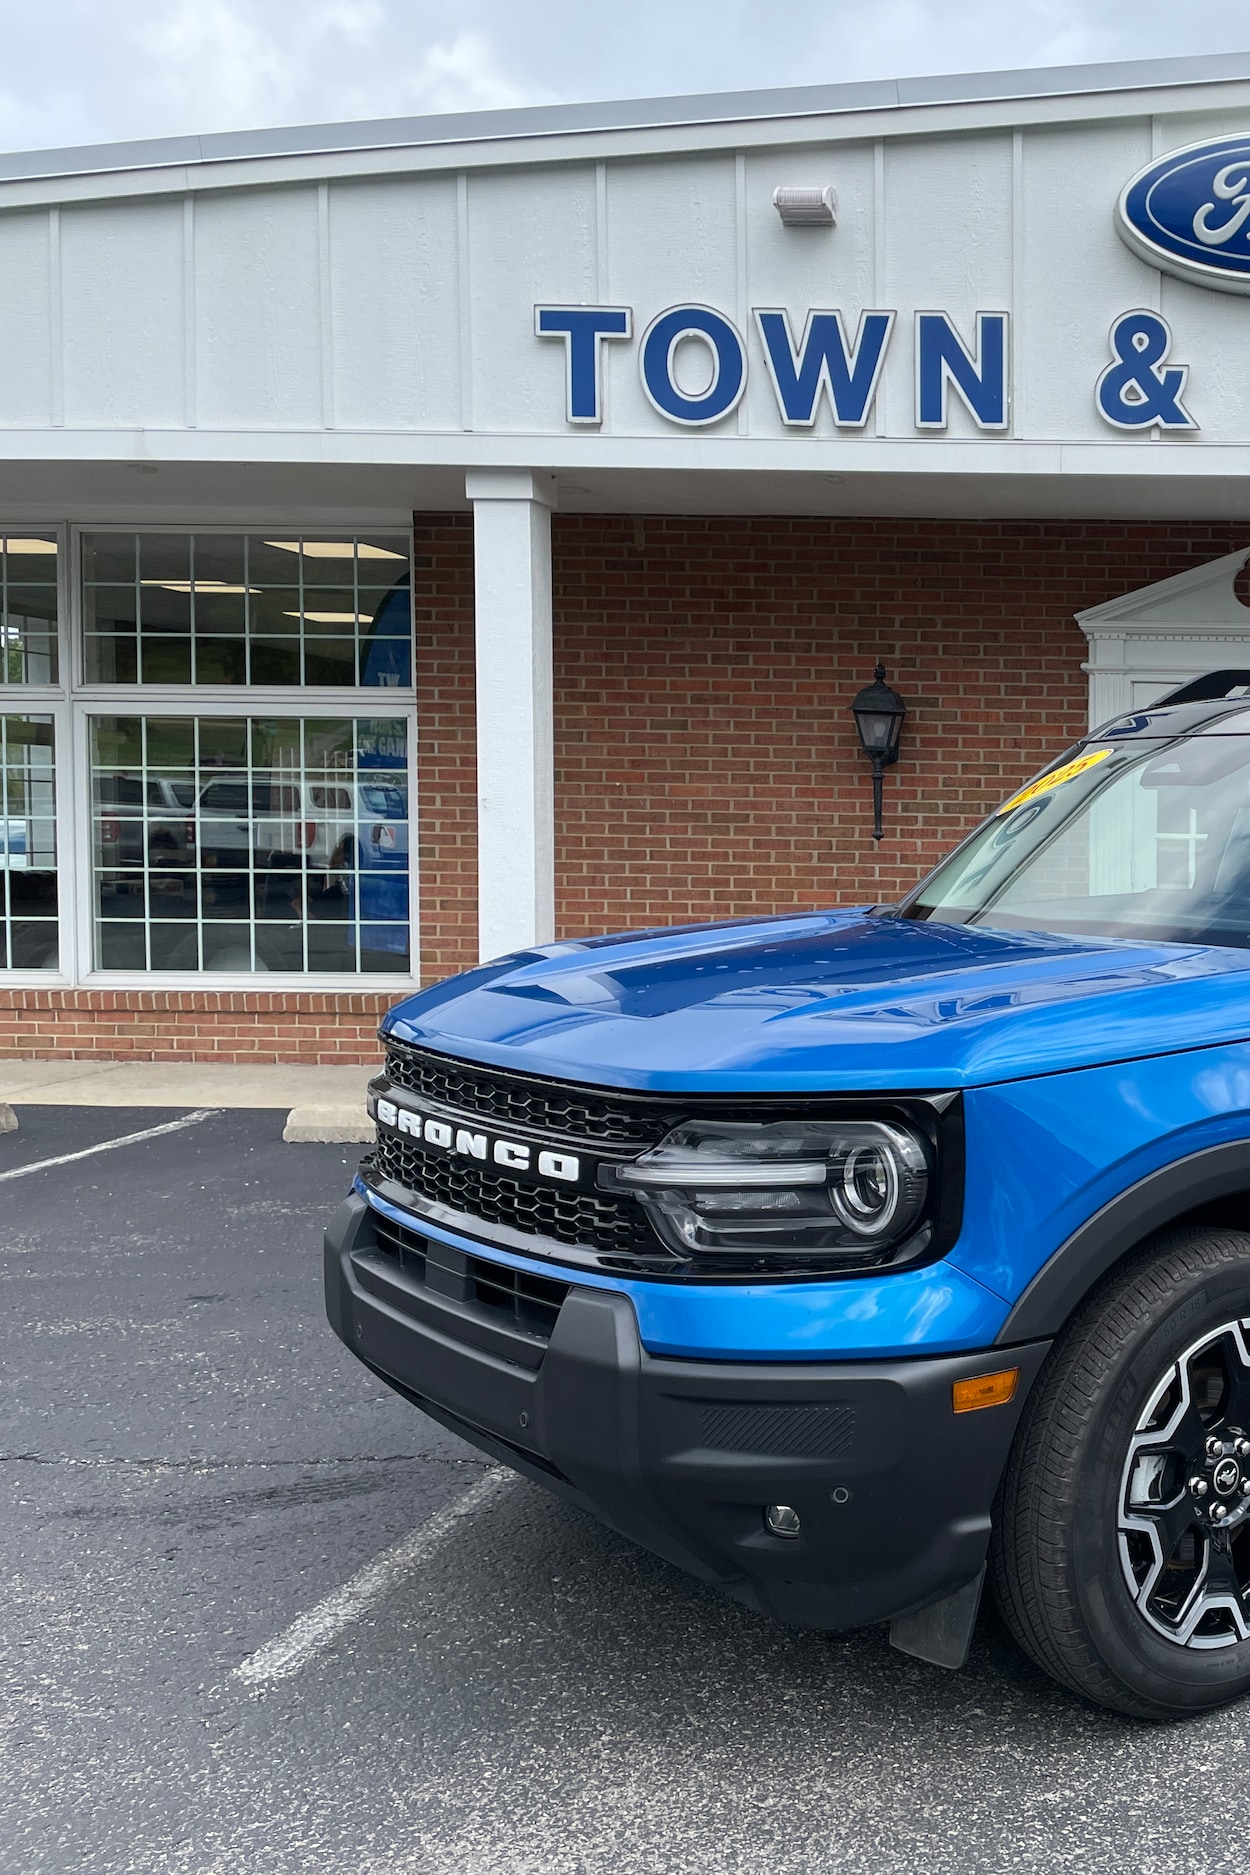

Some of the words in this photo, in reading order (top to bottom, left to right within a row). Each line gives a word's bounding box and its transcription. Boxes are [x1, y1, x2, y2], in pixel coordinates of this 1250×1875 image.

[534, 303, 1011, 430] TOWN
[1094, 308, 1201, 432] &
[1009, 757, 1097, 808] 2025
[377, 1099, 580, 1182] BRONCO
